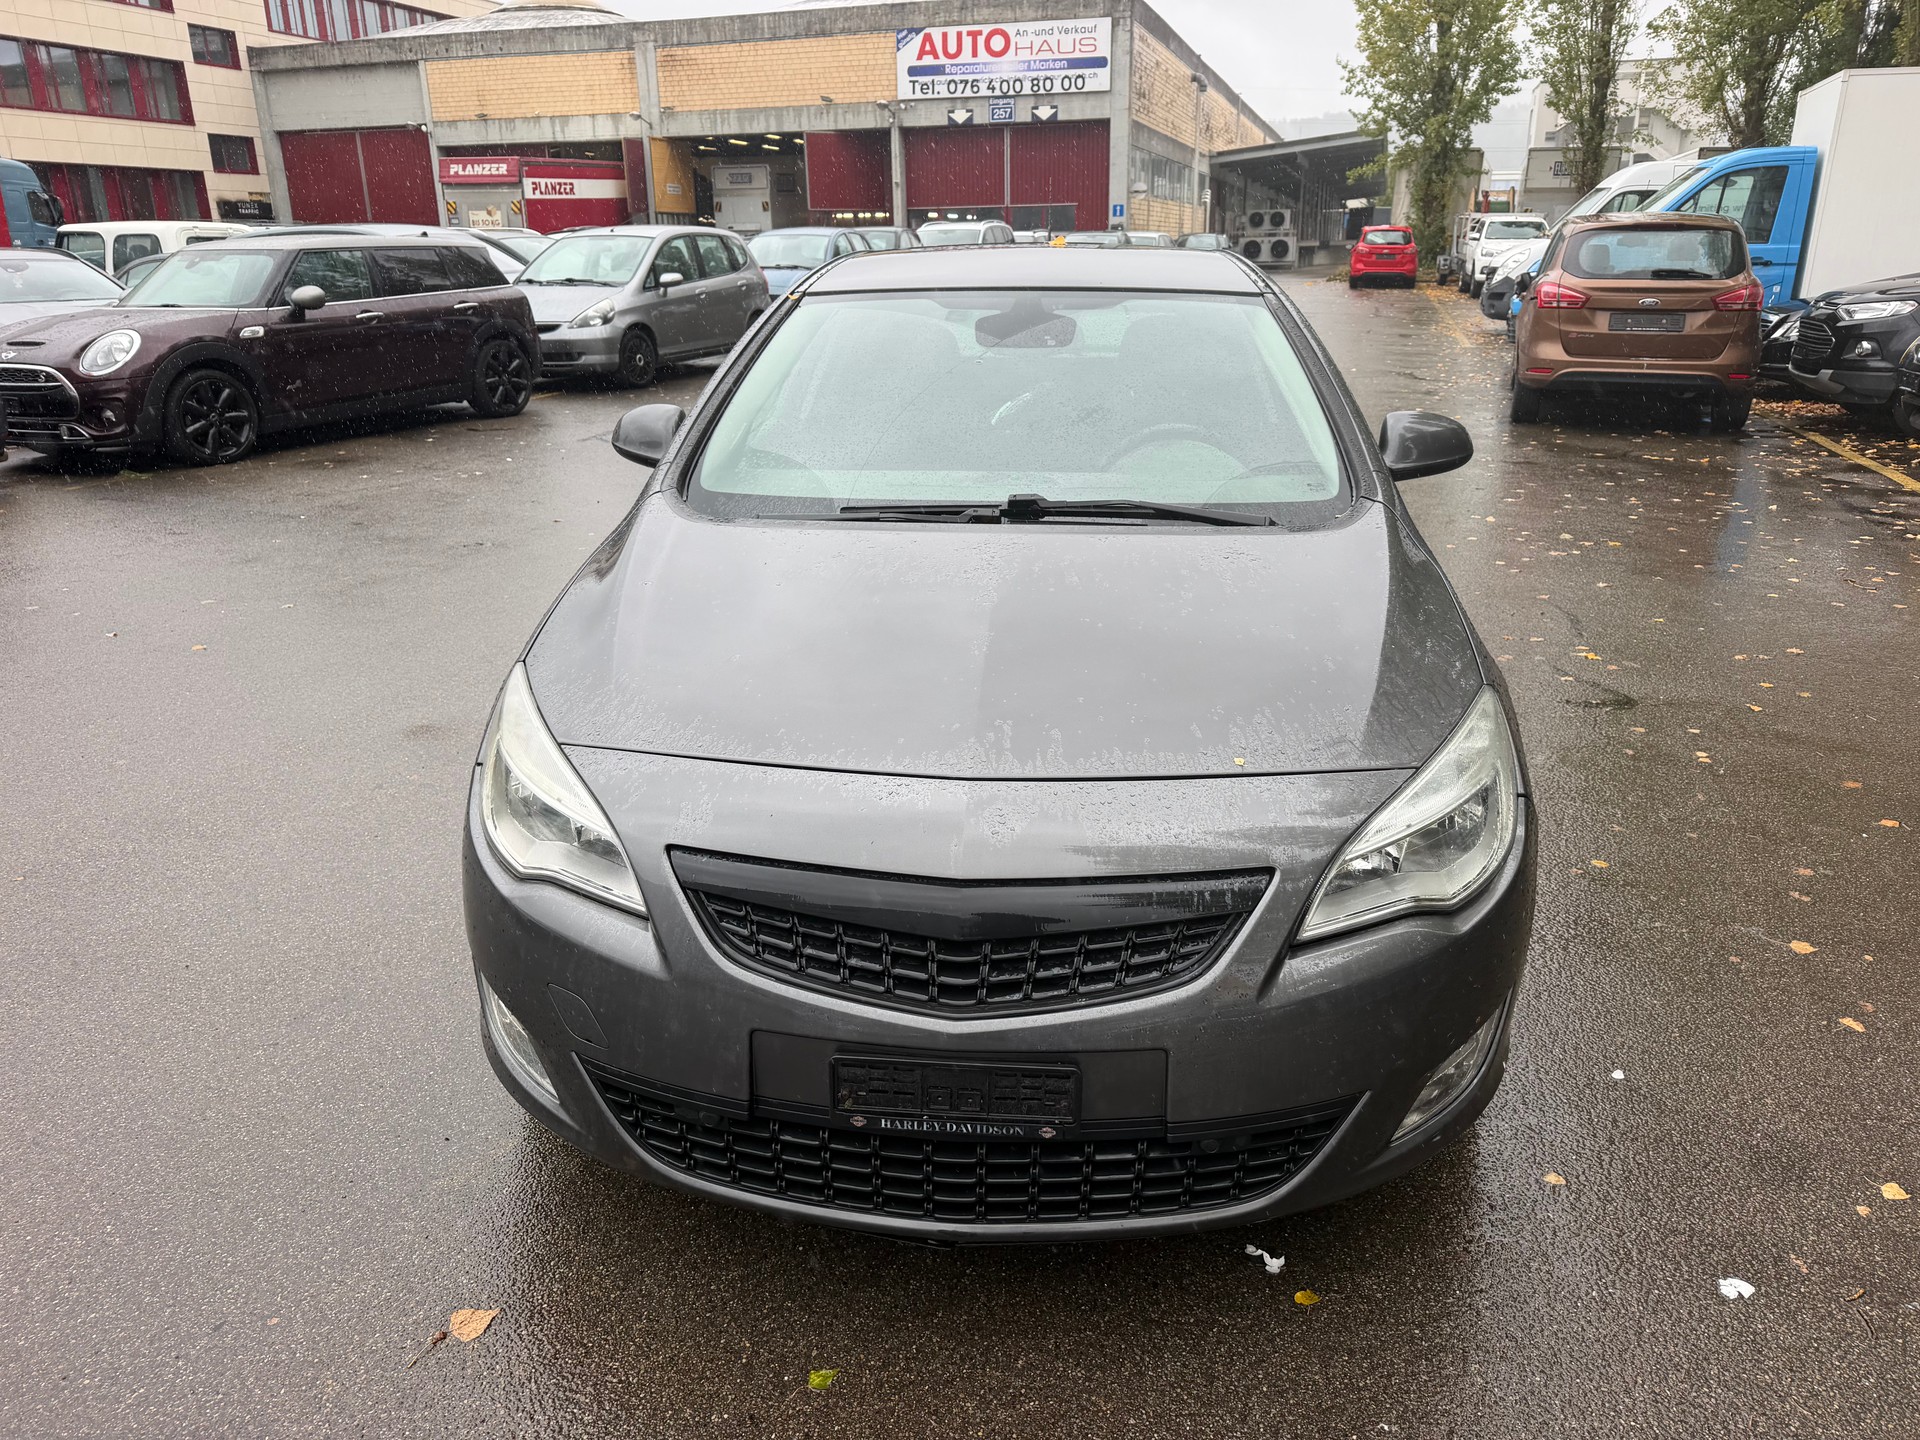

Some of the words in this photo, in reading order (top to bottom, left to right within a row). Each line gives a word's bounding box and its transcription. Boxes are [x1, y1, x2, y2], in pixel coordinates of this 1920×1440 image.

[1015, 28, 1028, 37] An
[1057, 24, 1097, 34] Verkauf
[916, 28, 1011, 61] AUTO
[1015, 37, 1097, 56] HAUS
[1030, 60, 1068, 70] Marken
[909, 79, 941, 95] Tel.
[947, 79, 980, 95] 076
[987, 79, 1023, 95] 400
[1030, 77, 1054, 93] 80
[1061, 74, 1085, 91] 00
[990, 97, 1014, 105] Eingang
[993, 108, 1011, 119] 257
[449, 164, 508, 175] PLANZER
[531, 181, 576, 196] PLANZER
[881, 1118, 1025, 1136] HARLEY-DAVIDSON
